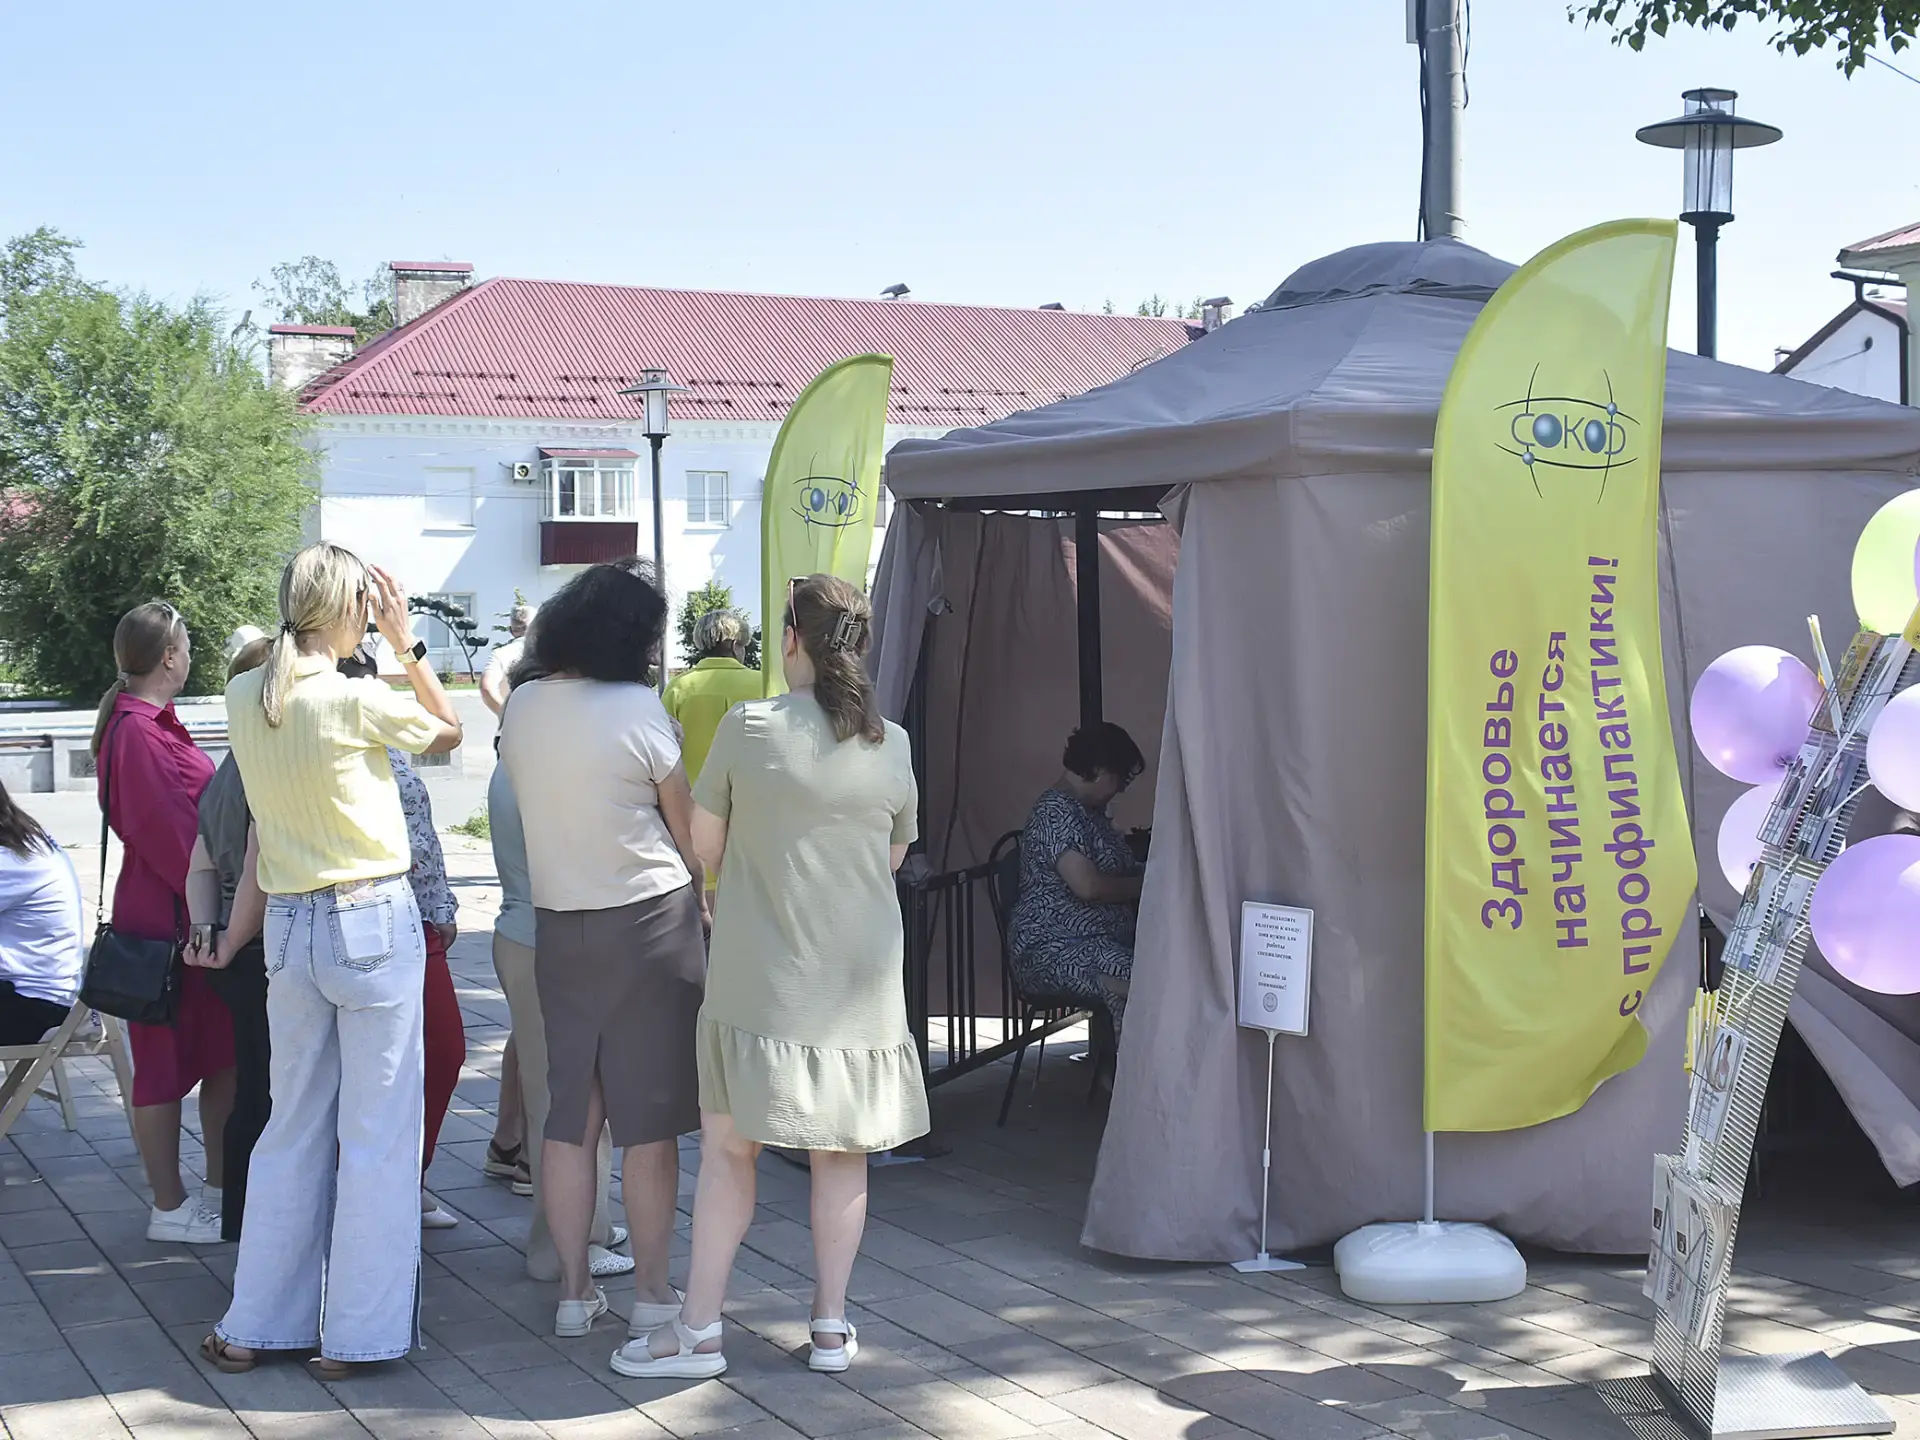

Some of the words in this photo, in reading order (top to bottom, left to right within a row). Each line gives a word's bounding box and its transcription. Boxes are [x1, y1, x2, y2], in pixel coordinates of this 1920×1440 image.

[1481, 648, 1528, 930] Здоровье
[1538, 631, 1588, 949] начинается
[1587, 556, 1663, 976] профилактики!
[1619, 989, 1643, 1017] с
